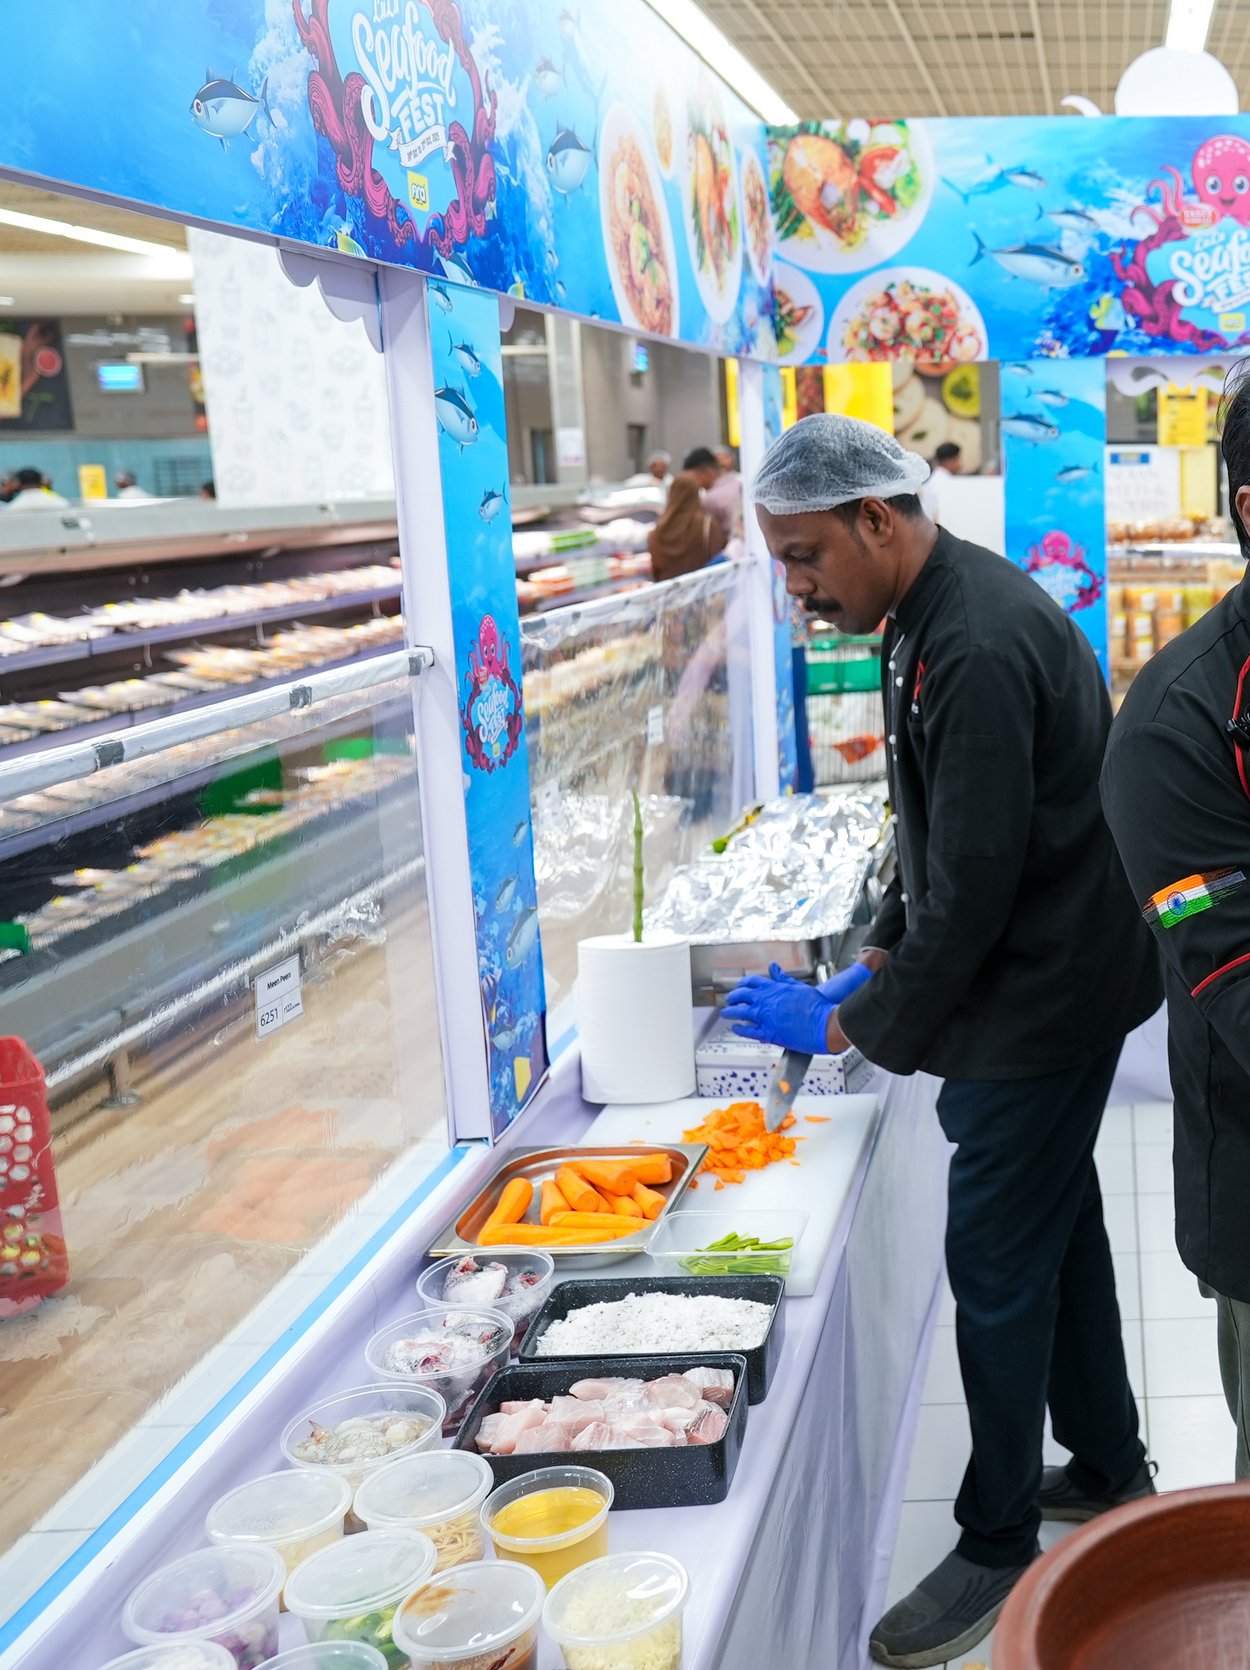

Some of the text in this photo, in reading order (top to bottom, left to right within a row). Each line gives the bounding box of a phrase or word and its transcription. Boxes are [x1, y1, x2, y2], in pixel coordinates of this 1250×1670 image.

[352, 2, 456, 140] Seafood
[399, 92, 445, 143] FEST
[477, 682, 510, 744] Seafood
[260, 1007, 278, 1027] 6251
